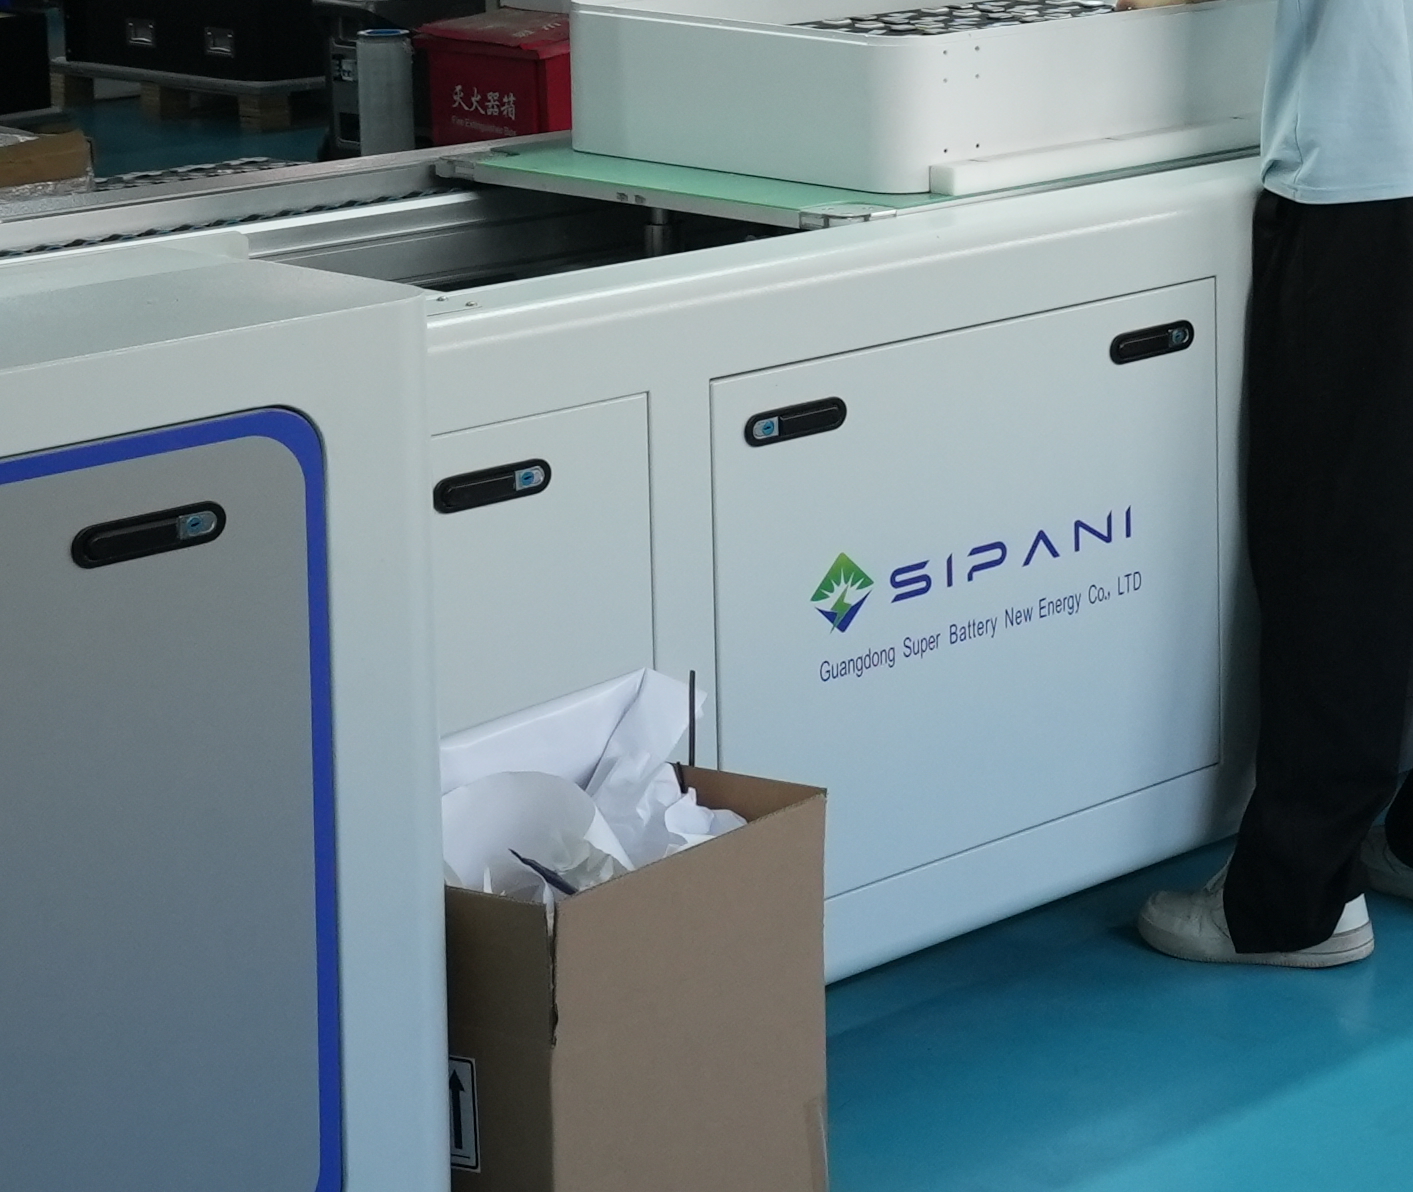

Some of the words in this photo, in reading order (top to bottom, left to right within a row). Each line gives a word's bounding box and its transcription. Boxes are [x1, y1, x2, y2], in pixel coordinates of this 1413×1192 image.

[452, 85, 517, 121] 灭火器箱
[890, 505, 1132, 604] SIPANI
[819, 645, 896, 683] Guangdong
[902, 632, 941, 659] Super
[949, 616, 998, 646] Battery
[1004, 603, 1034, 629] New
[1038, 591, 1082, 619] Energy
[1087, 584, 1111, 605] Co.,
[1117, 571, 1142, 597] LTD
